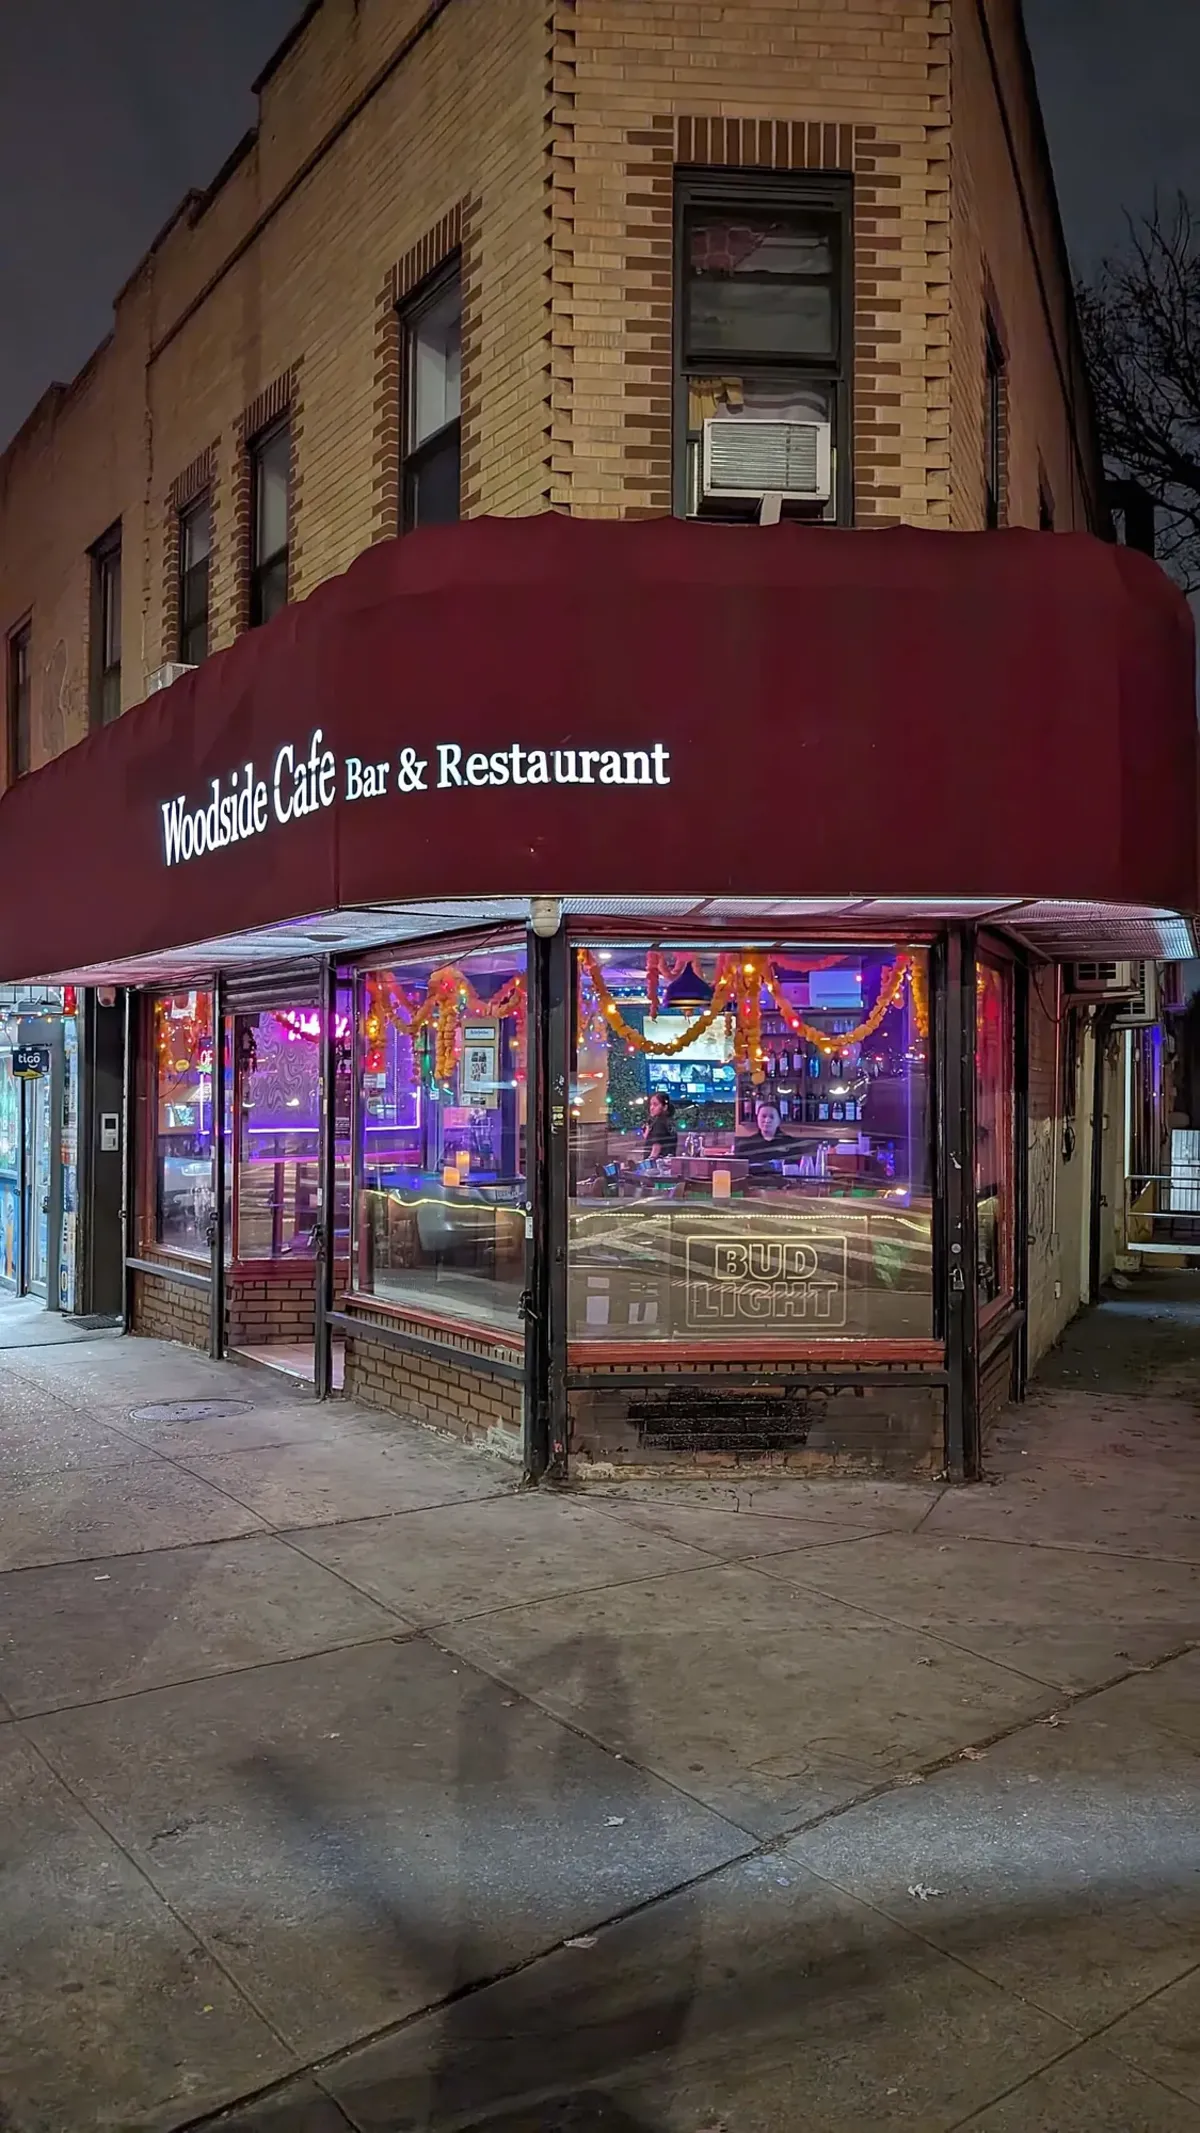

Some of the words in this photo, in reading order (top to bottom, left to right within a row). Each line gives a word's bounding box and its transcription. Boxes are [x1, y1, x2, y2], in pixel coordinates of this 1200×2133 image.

[161, 762, 268, 867] Woodside
[273, 728, 336, 824] Cafe
[344, 757, 390, 801] Bar
[397, 747, 428, 793] &
[435, 743, 671, 789] Restaurant
[715, 1243, 818, 1280] BUD
[693, 1281, 839, 1319] LIGHT
